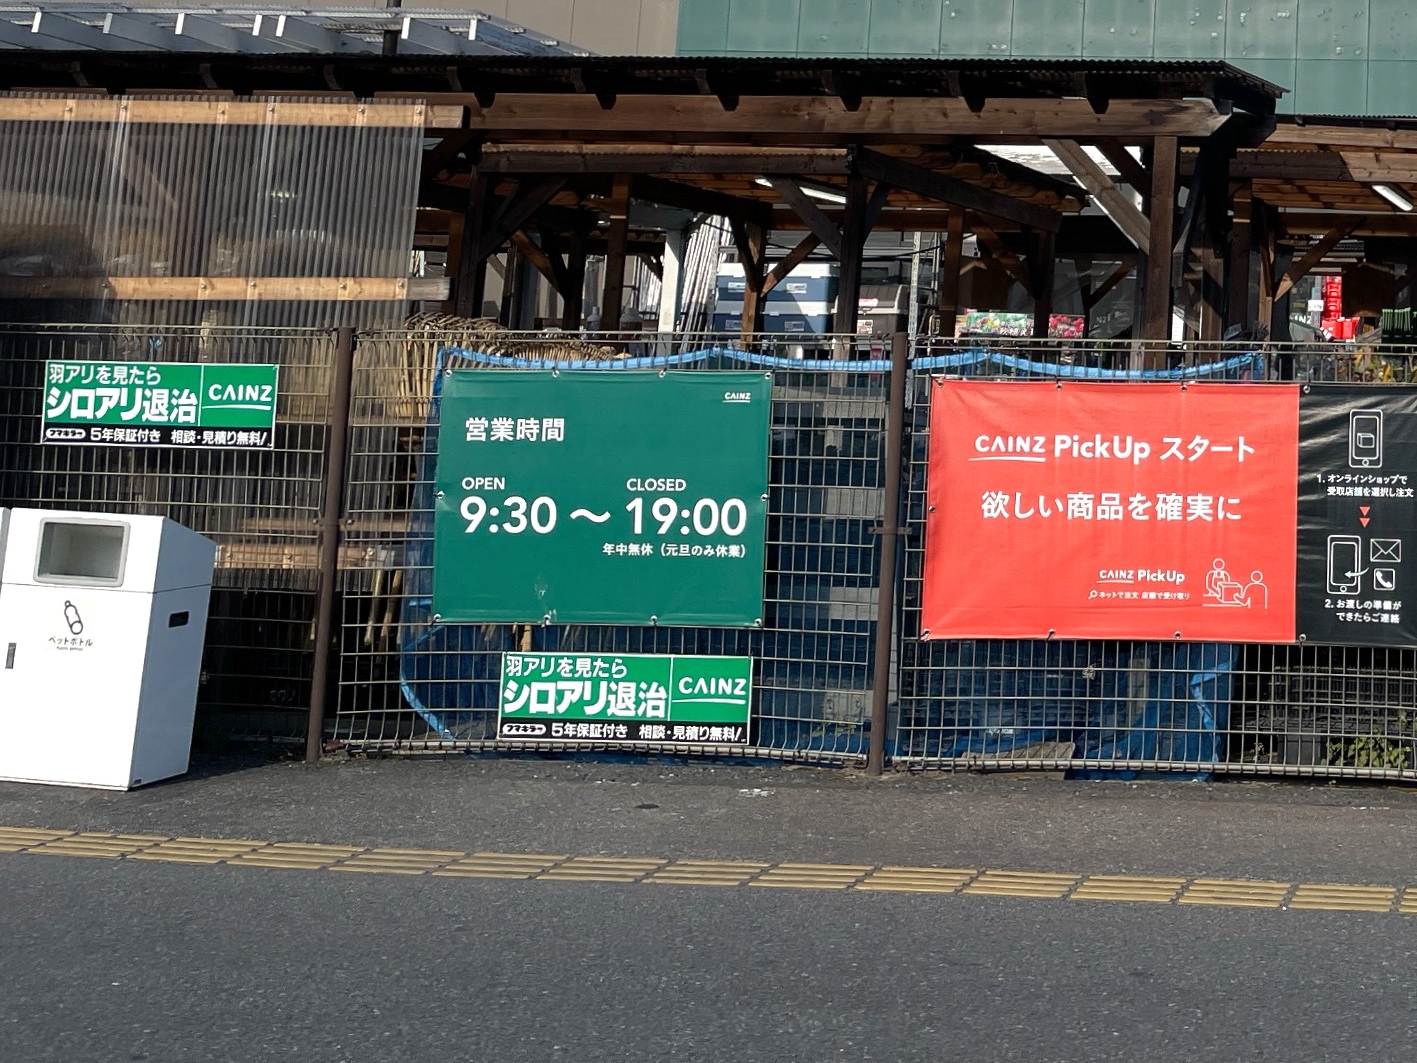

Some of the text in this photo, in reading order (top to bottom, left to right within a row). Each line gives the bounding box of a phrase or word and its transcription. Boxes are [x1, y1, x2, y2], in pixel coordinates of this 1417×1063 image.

[49, 364, 161, 385] 羽アリを見たら
[208, 383, 273, 402] CAINZ
[724, 392, 752, 401] CAINZ
[46, 387, 198, 423] シロアリ退治
[90, 427, 161, 443] 5年保証付き
[464, 417, 566, 442] 営業時間
[974, 434, 1256, 464] CAINZ PickUp スタート
[462, 477, 687, 492] OPEN CLOSED
[981, 490, 1242, 522] 欲しい商品を確実に
[459, 496, 558, 535] 9:30
[625, 497, 748, 537] 19:00
[1099, 569, 1185, 585] CAINZ PickUp
[1335, 612, 1400, 624] できたらご連絡
[506, 655, 628, 678] 羽アリを見たら
[678, 677, 747, 696] CAINZ
[503, 679, 668, 718] シロアリ退治
[551, 722, 628, 738] 5年保証付き
